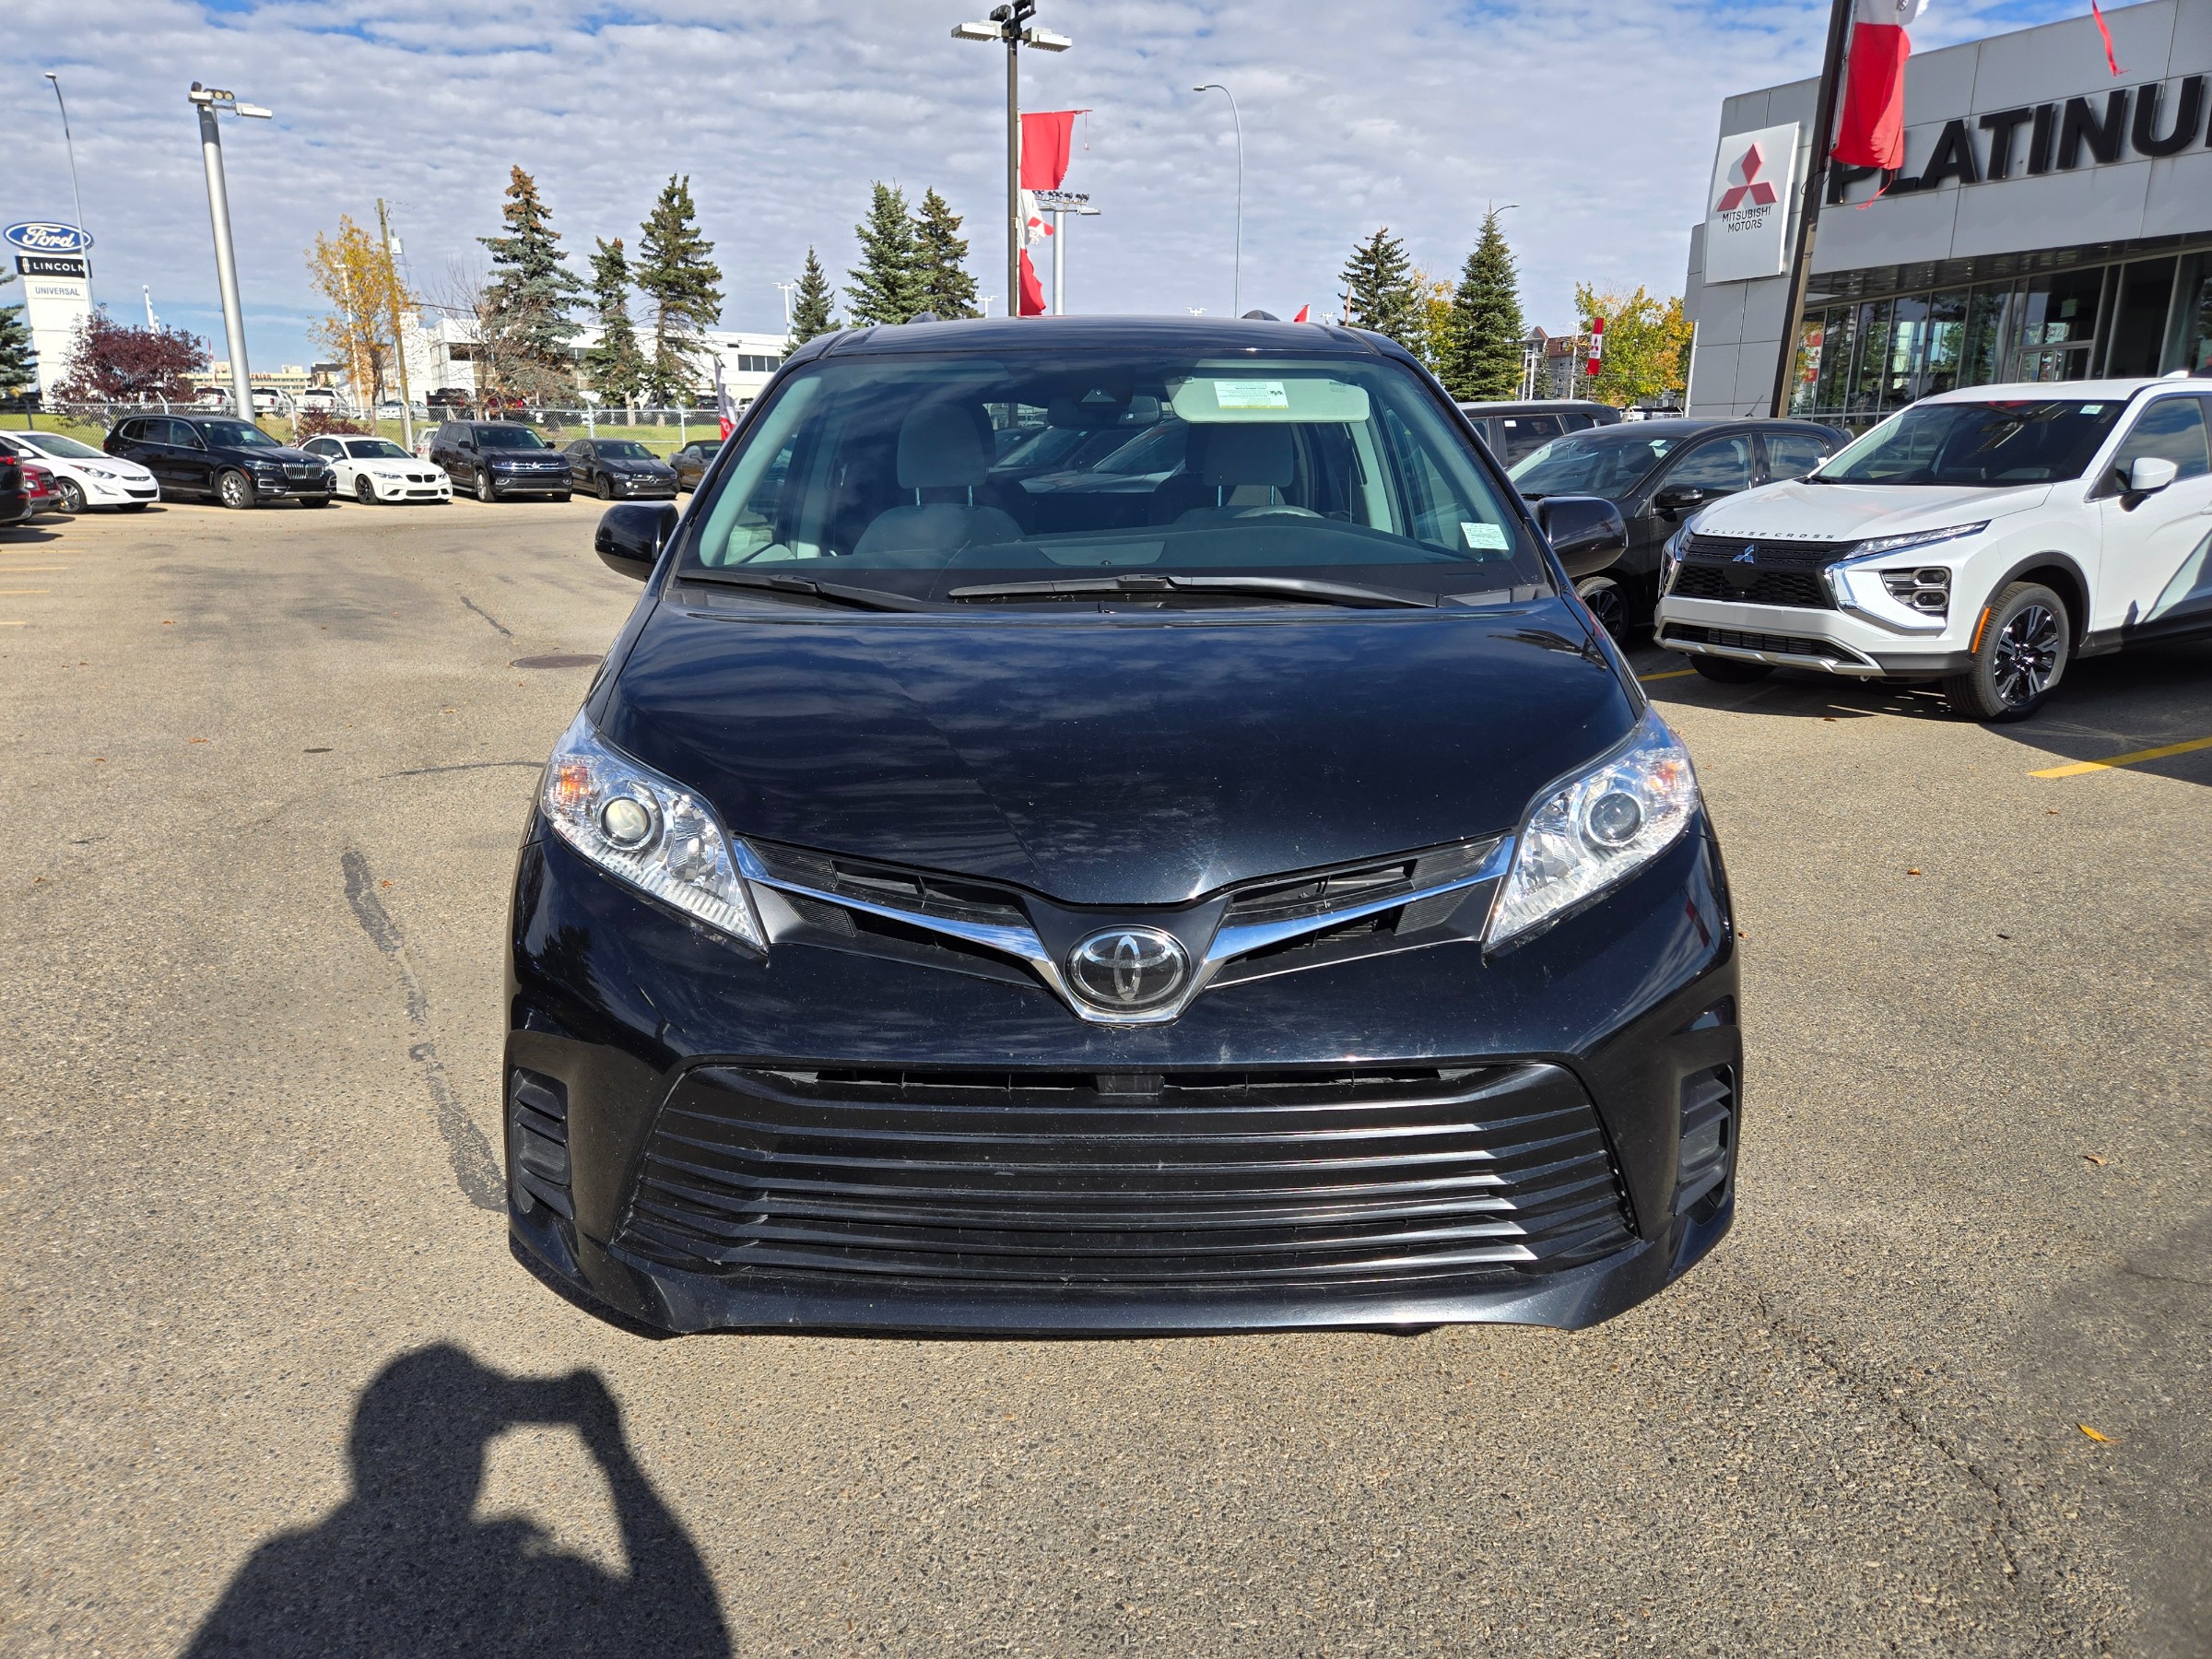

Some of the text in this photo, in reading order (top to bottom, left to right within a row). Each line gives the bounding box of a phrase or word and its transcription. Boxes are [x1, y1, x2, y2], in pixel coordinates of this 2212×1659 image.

[1825, 76, 2212, 205] PLATINU
[1722, 206, 1771, 223] MITSUBISHI
[1727, 218, 1762, 233] MOTORS
[22, 225, 75, 248] Ford
[33, 262, 85, 273] LINCOLN
[35, 286, 80, 296] UNIVERSAL
[1703, 528, 1768, 537] ECLIPSE
